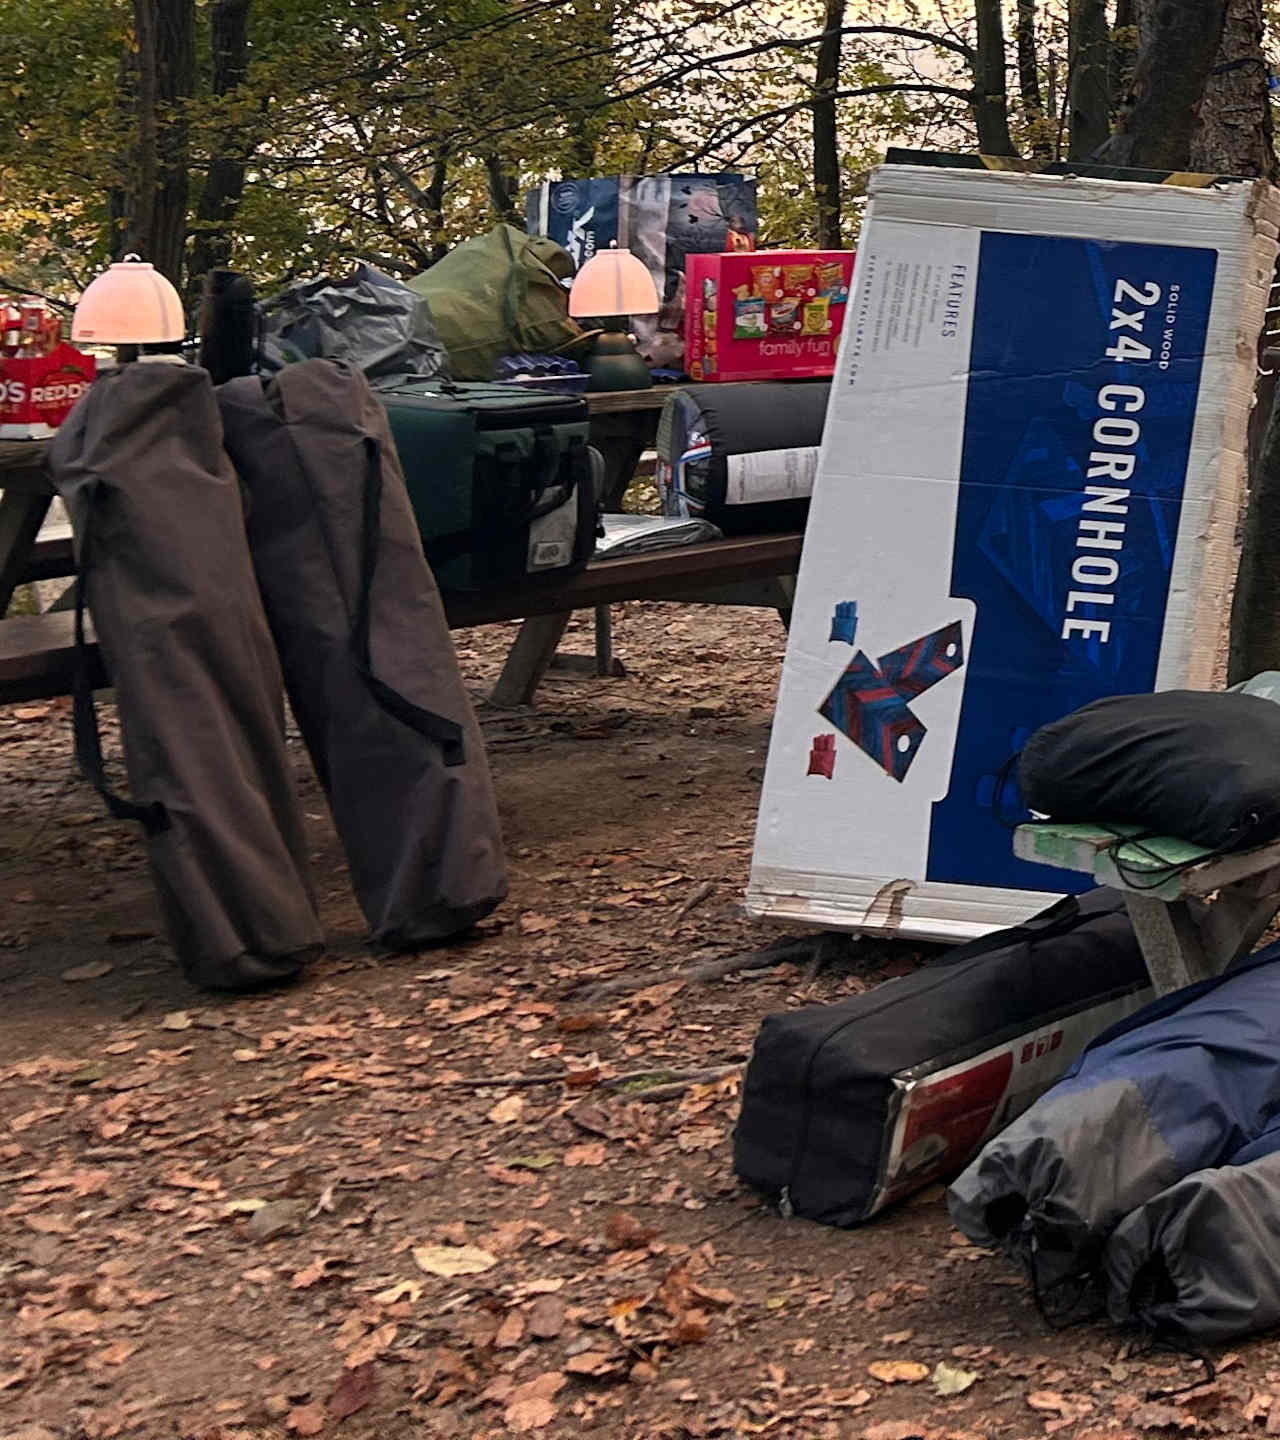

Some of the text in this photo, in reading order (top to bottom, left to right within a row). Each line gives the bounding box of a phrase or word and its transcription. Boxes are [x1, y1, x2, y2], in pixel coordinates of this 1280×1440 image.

[941, 264, 968, 337] FEATURES
[1159, 285, 1180, 370] SOLID WOOD
[759, 337, 831, 357] family fun
[30, 381, 89, 403] REDD'
[1061, 278, 1161, 643] 2x4 CORNHOLE
